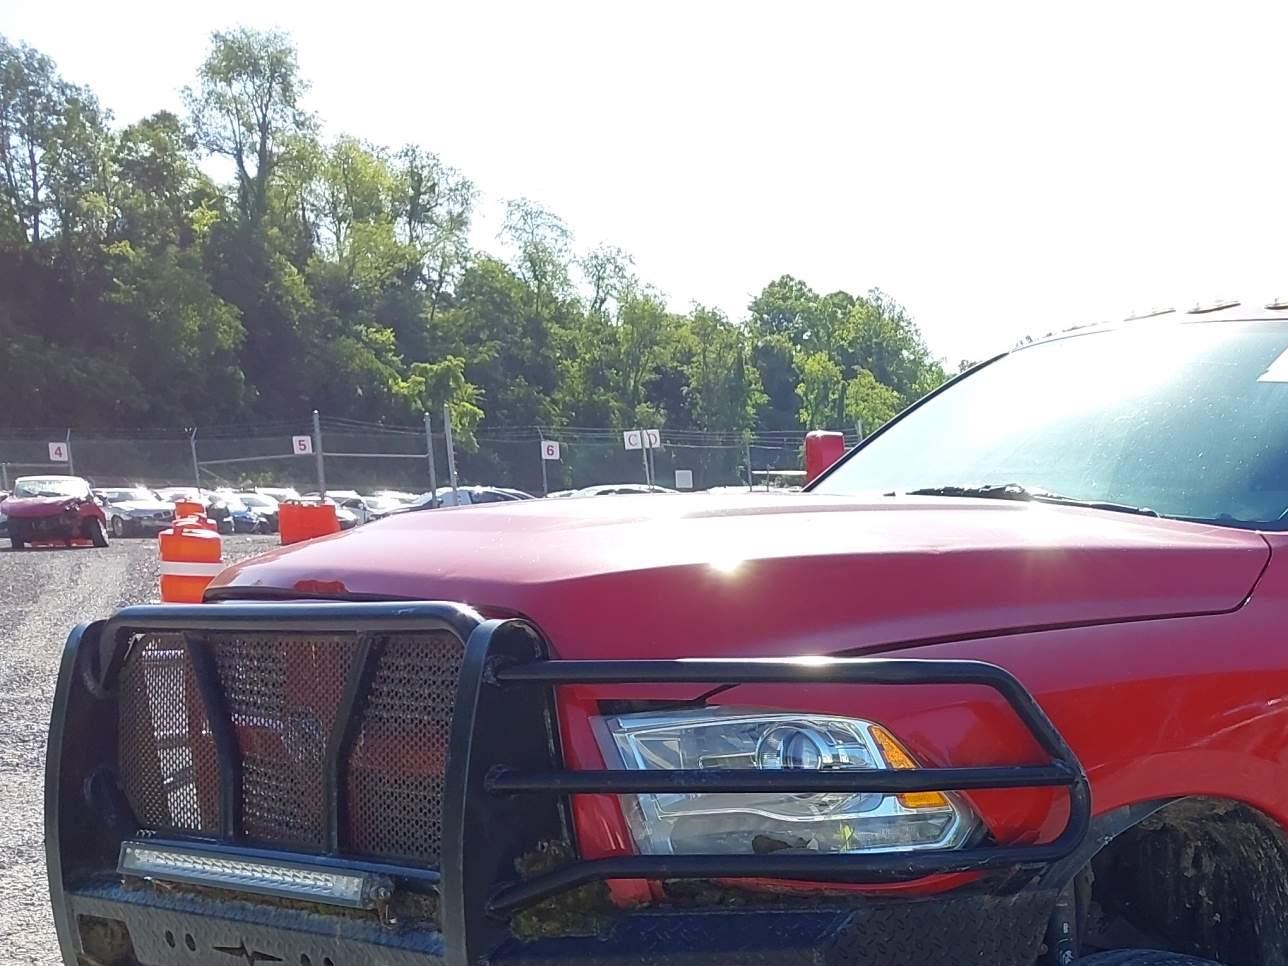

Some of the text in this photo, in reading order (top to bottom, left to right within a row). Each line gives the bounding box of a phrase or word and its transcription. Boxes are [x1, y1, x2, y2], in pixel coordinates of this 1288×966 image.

[298, 439, 307, 452] 5
[628, 433, 638, 447] C
[54, 446, 63, 458] 4
[546, 444, 555, 456] 6
